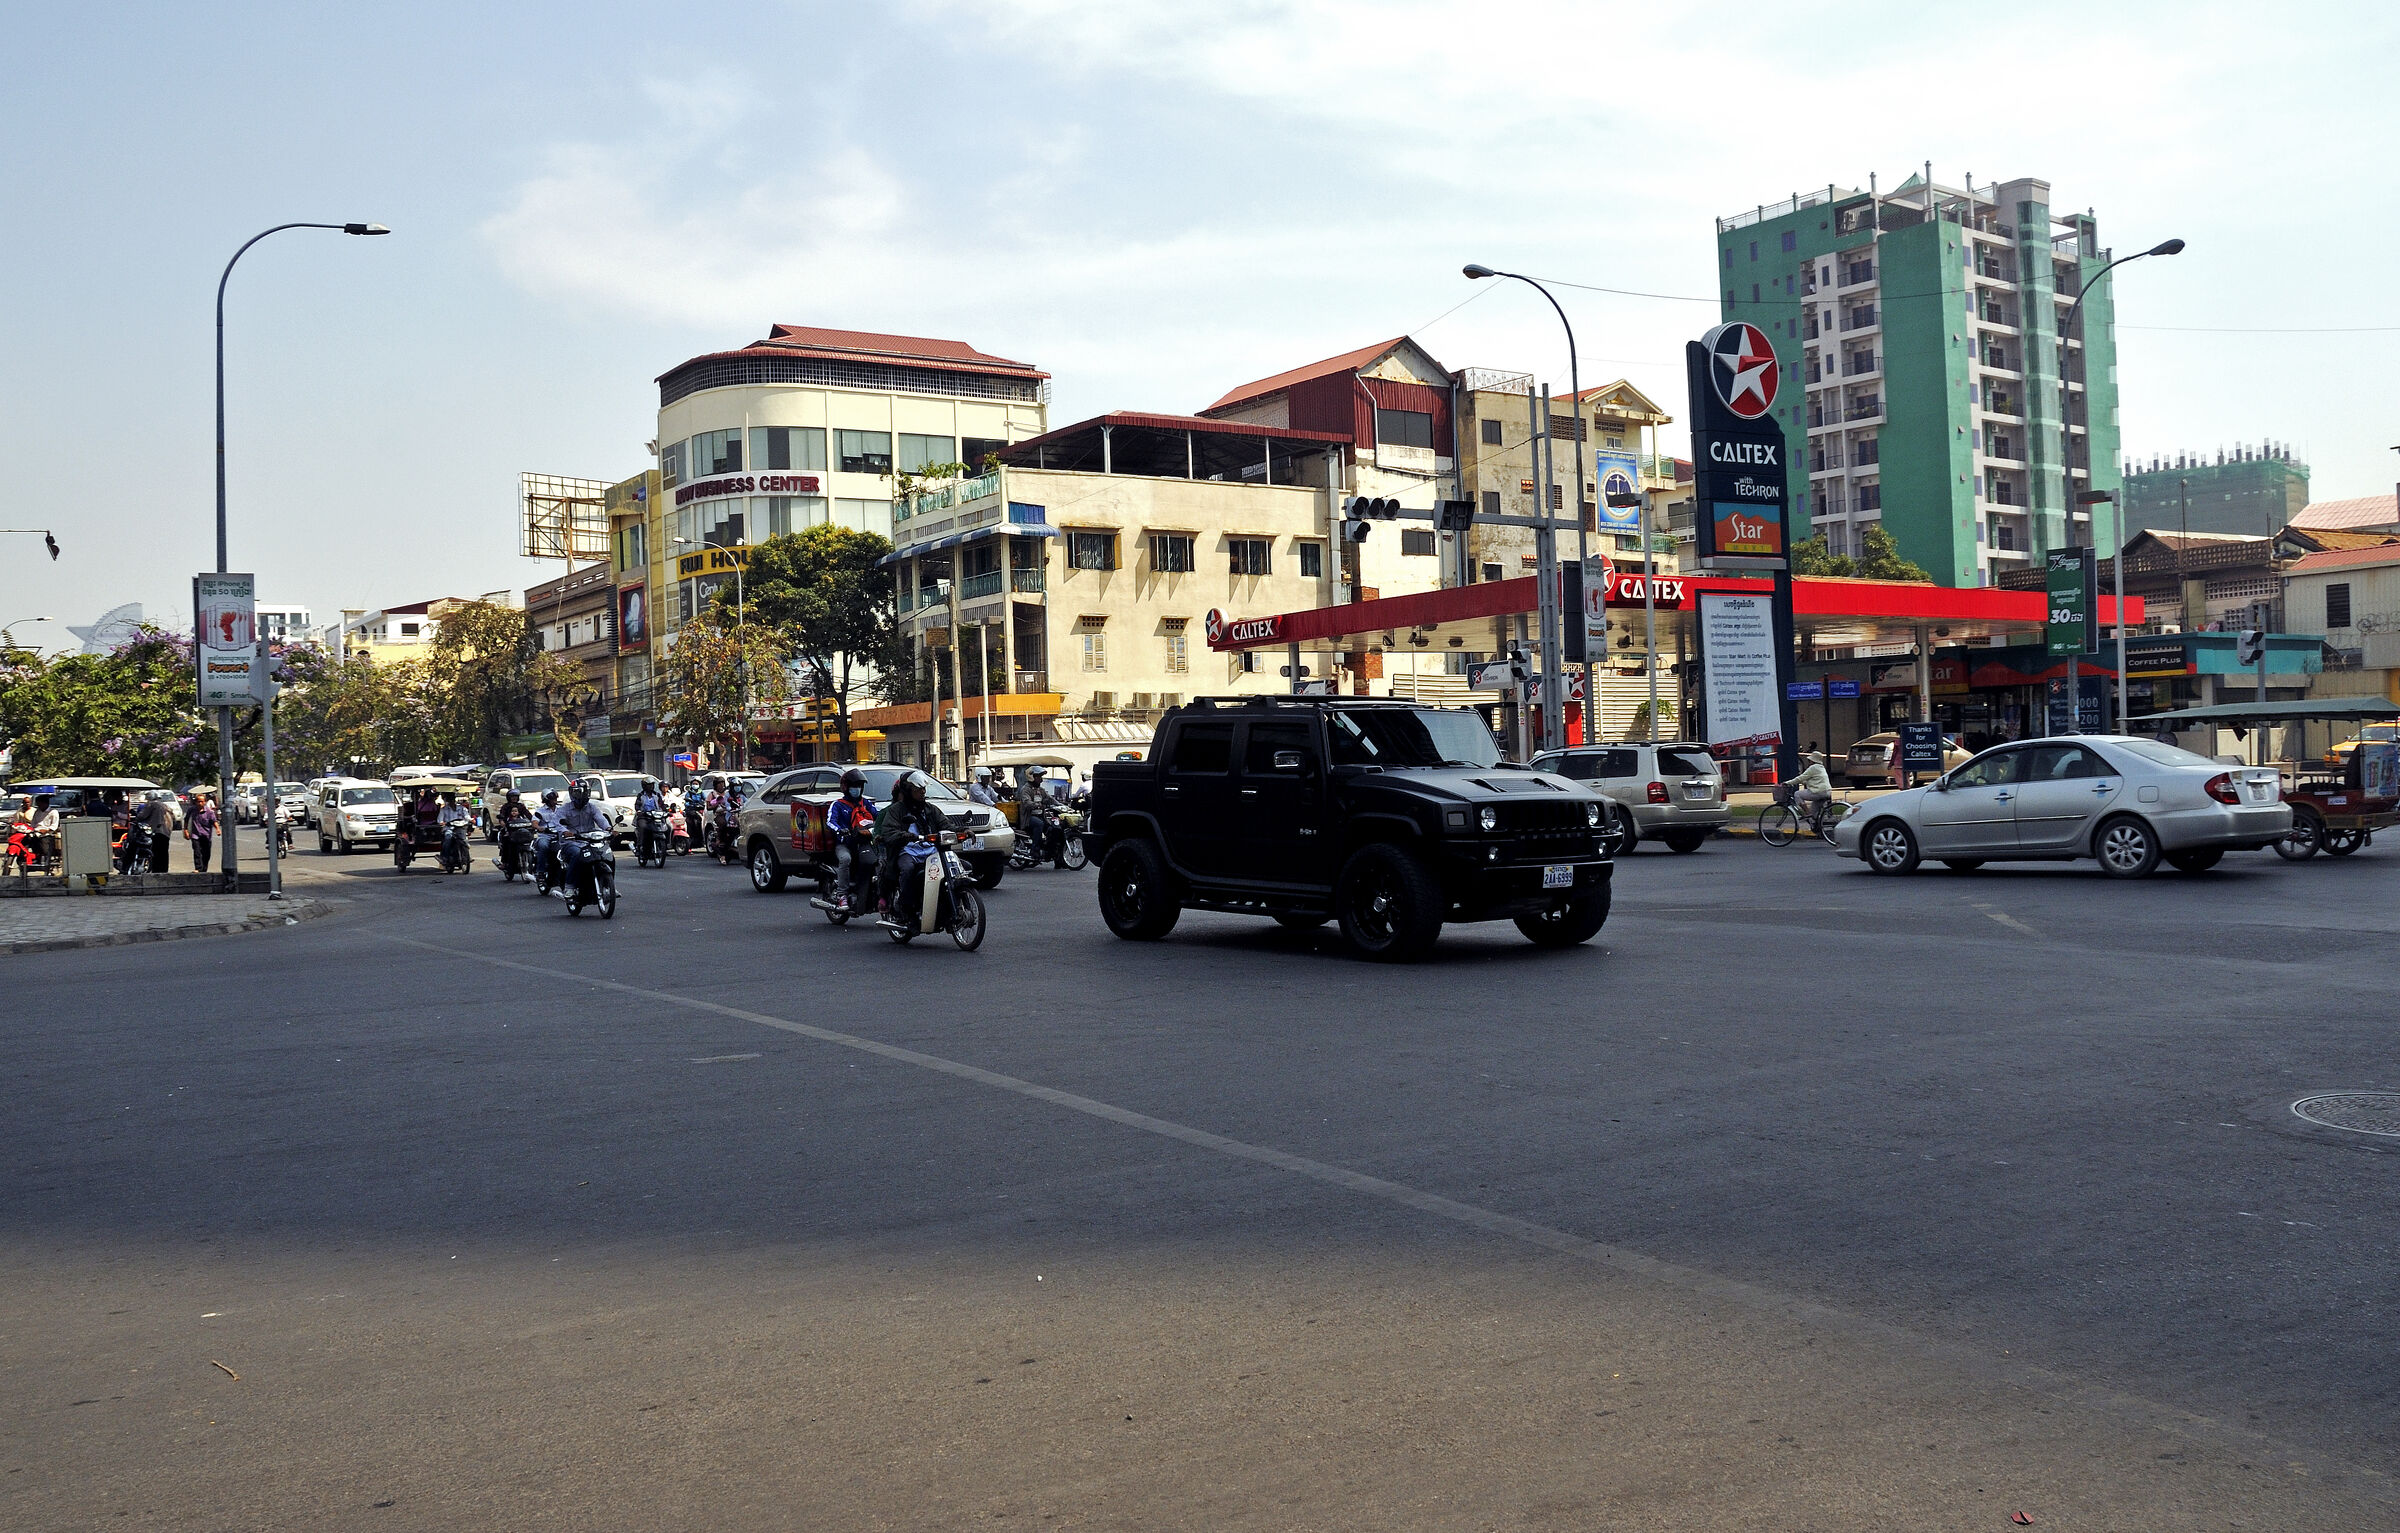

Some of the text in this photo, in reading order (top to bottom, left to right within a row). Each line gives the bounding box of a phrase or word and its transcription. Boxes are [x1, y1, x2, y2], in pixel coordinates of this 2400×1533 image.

[1710, 441, 1778, 465] CALTEX
[695, 476, 755, 498] BUSINESS
[759, 475, 820, 492] CENTER
[1739, 476, 1754, 484] with
[1734, 482, 1780, 500] TECHRON
[1732, 514, 1764, 542] Star
[680, 554, 703, 575] FUJI
[1620, 578, 1685, 600] CATEX
[2050, 608, 2070, 624] 30
[1232, 620, 1274, 640] CALTEX
[1930, 666, 1954, 680] tar
[1759, 732, 1777, 741] CALTEX
